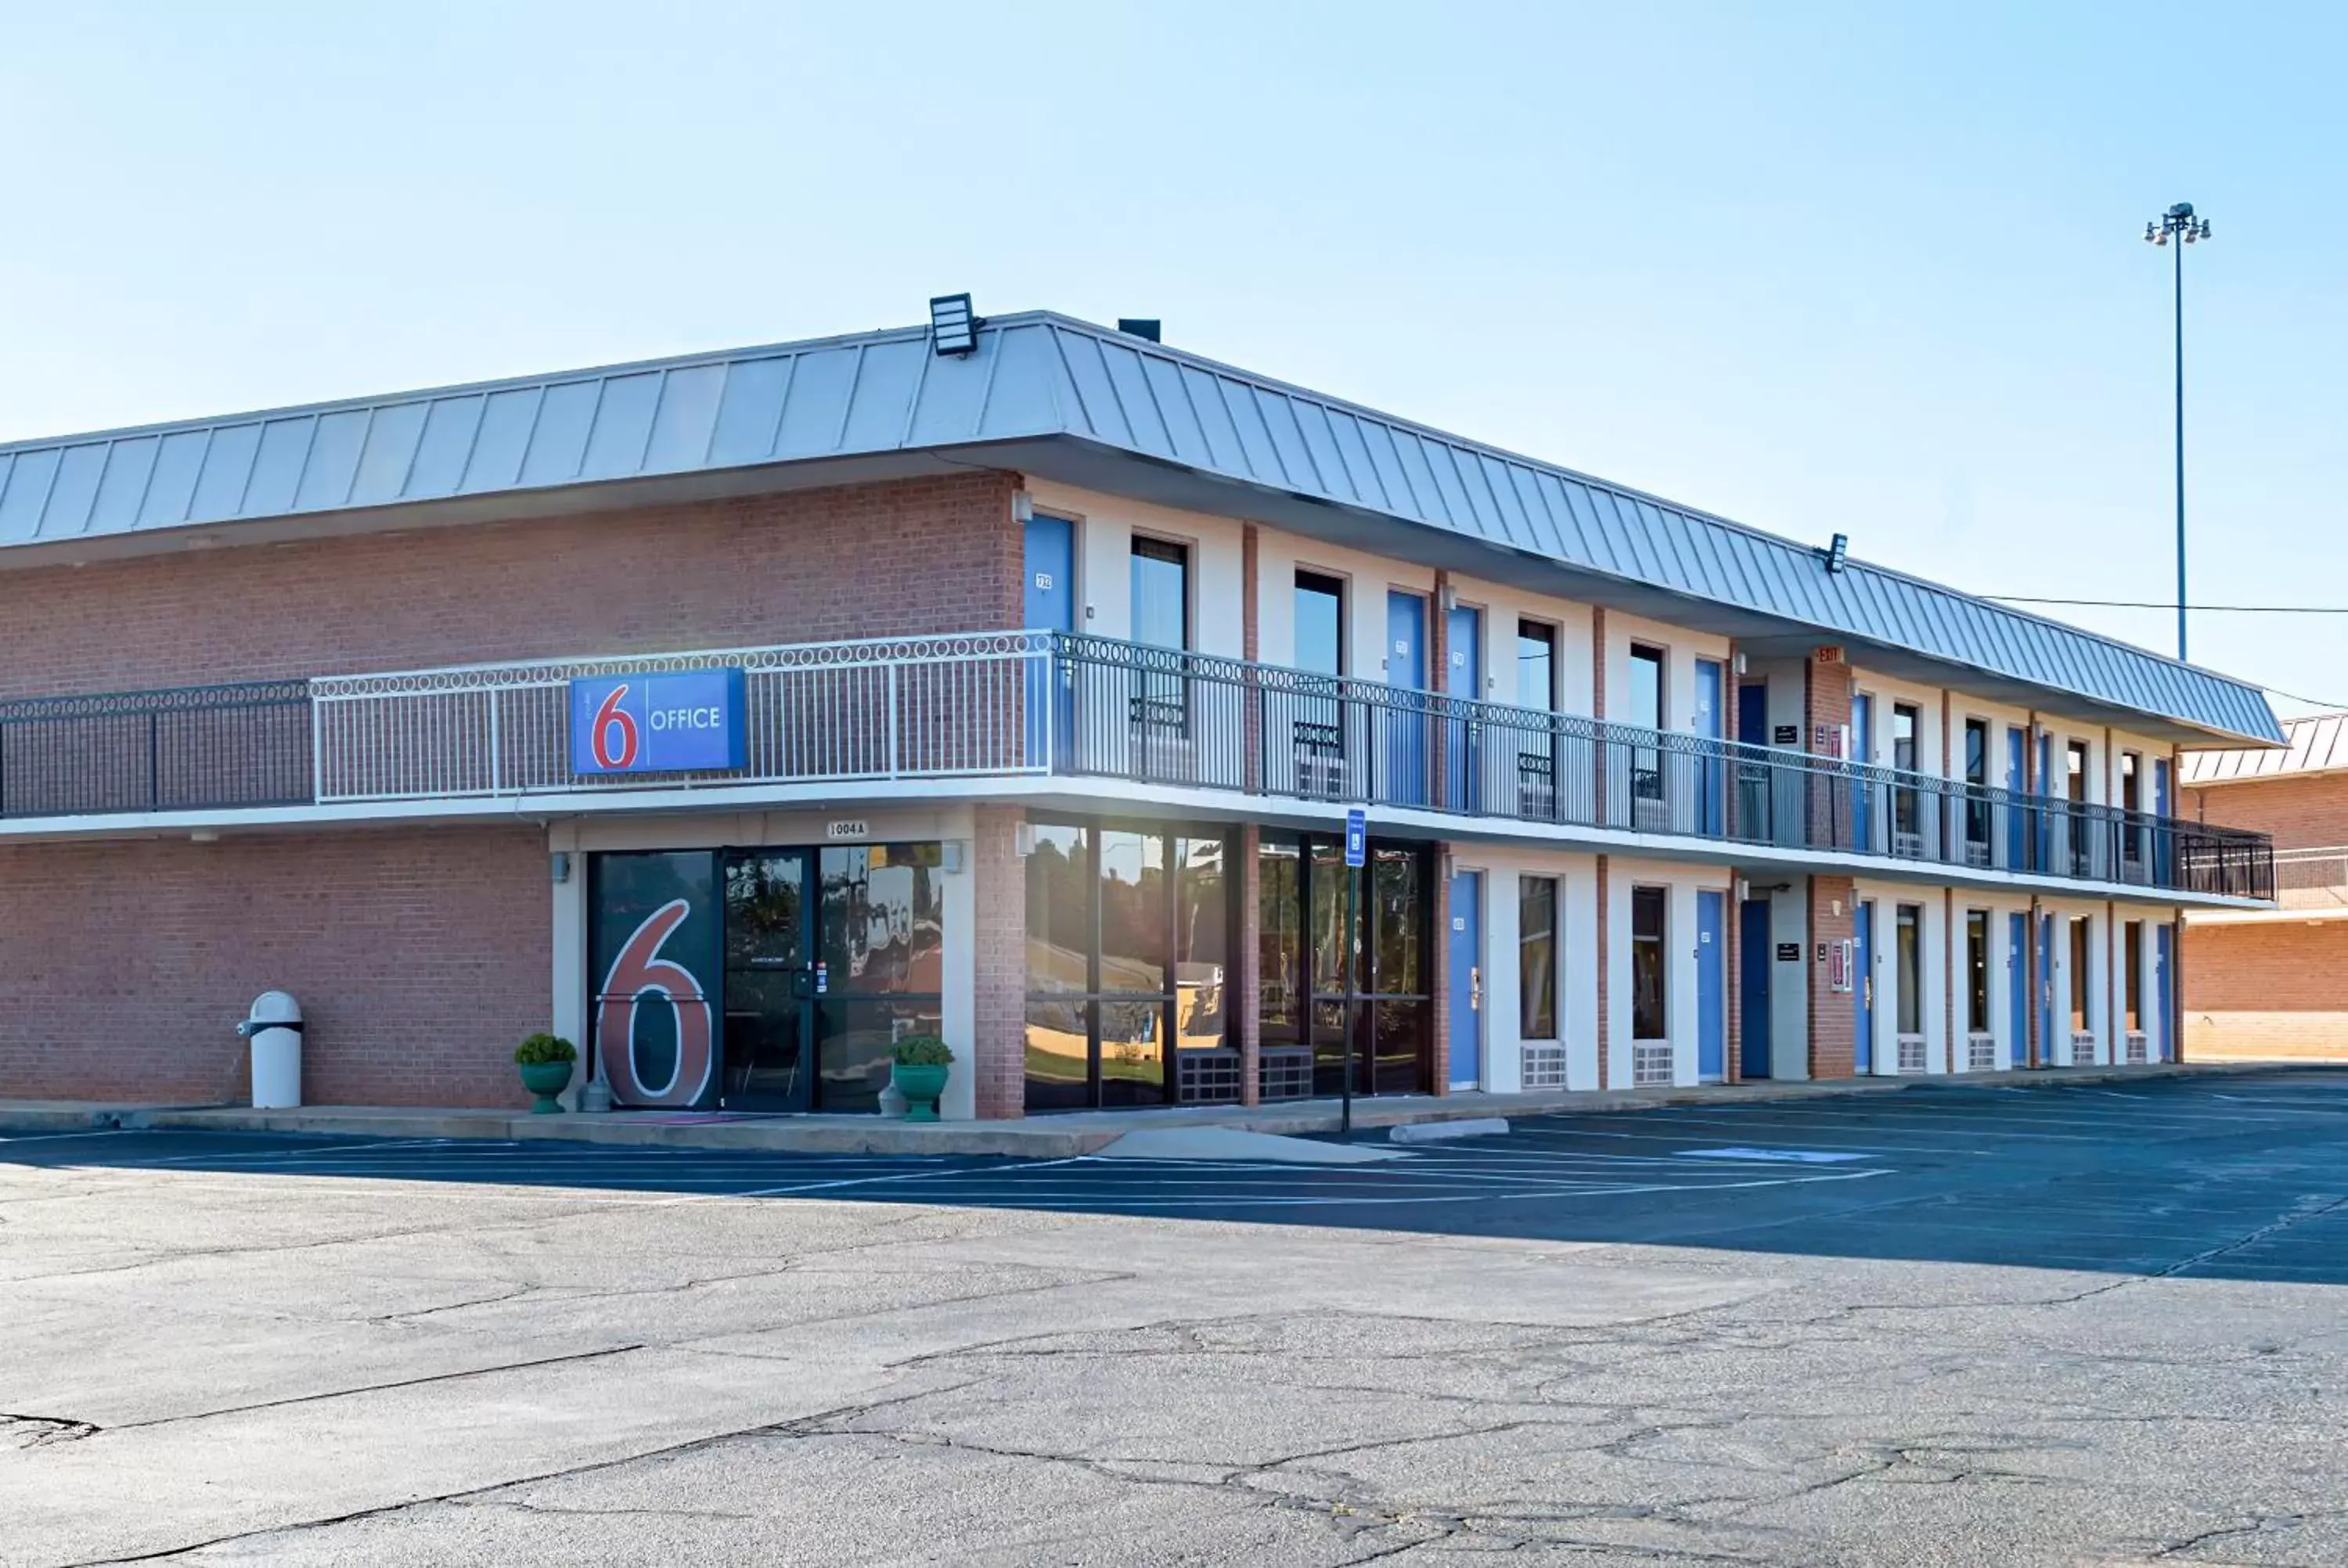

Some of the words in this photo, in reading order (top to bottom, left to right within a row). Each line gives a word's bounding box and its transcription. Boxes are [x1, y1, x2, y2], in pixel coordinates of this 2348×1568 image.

[592, 683, 638, 768] 6
[650, 707, 720, 731] OFFICE
[597, 898, 712, 1106] 6
